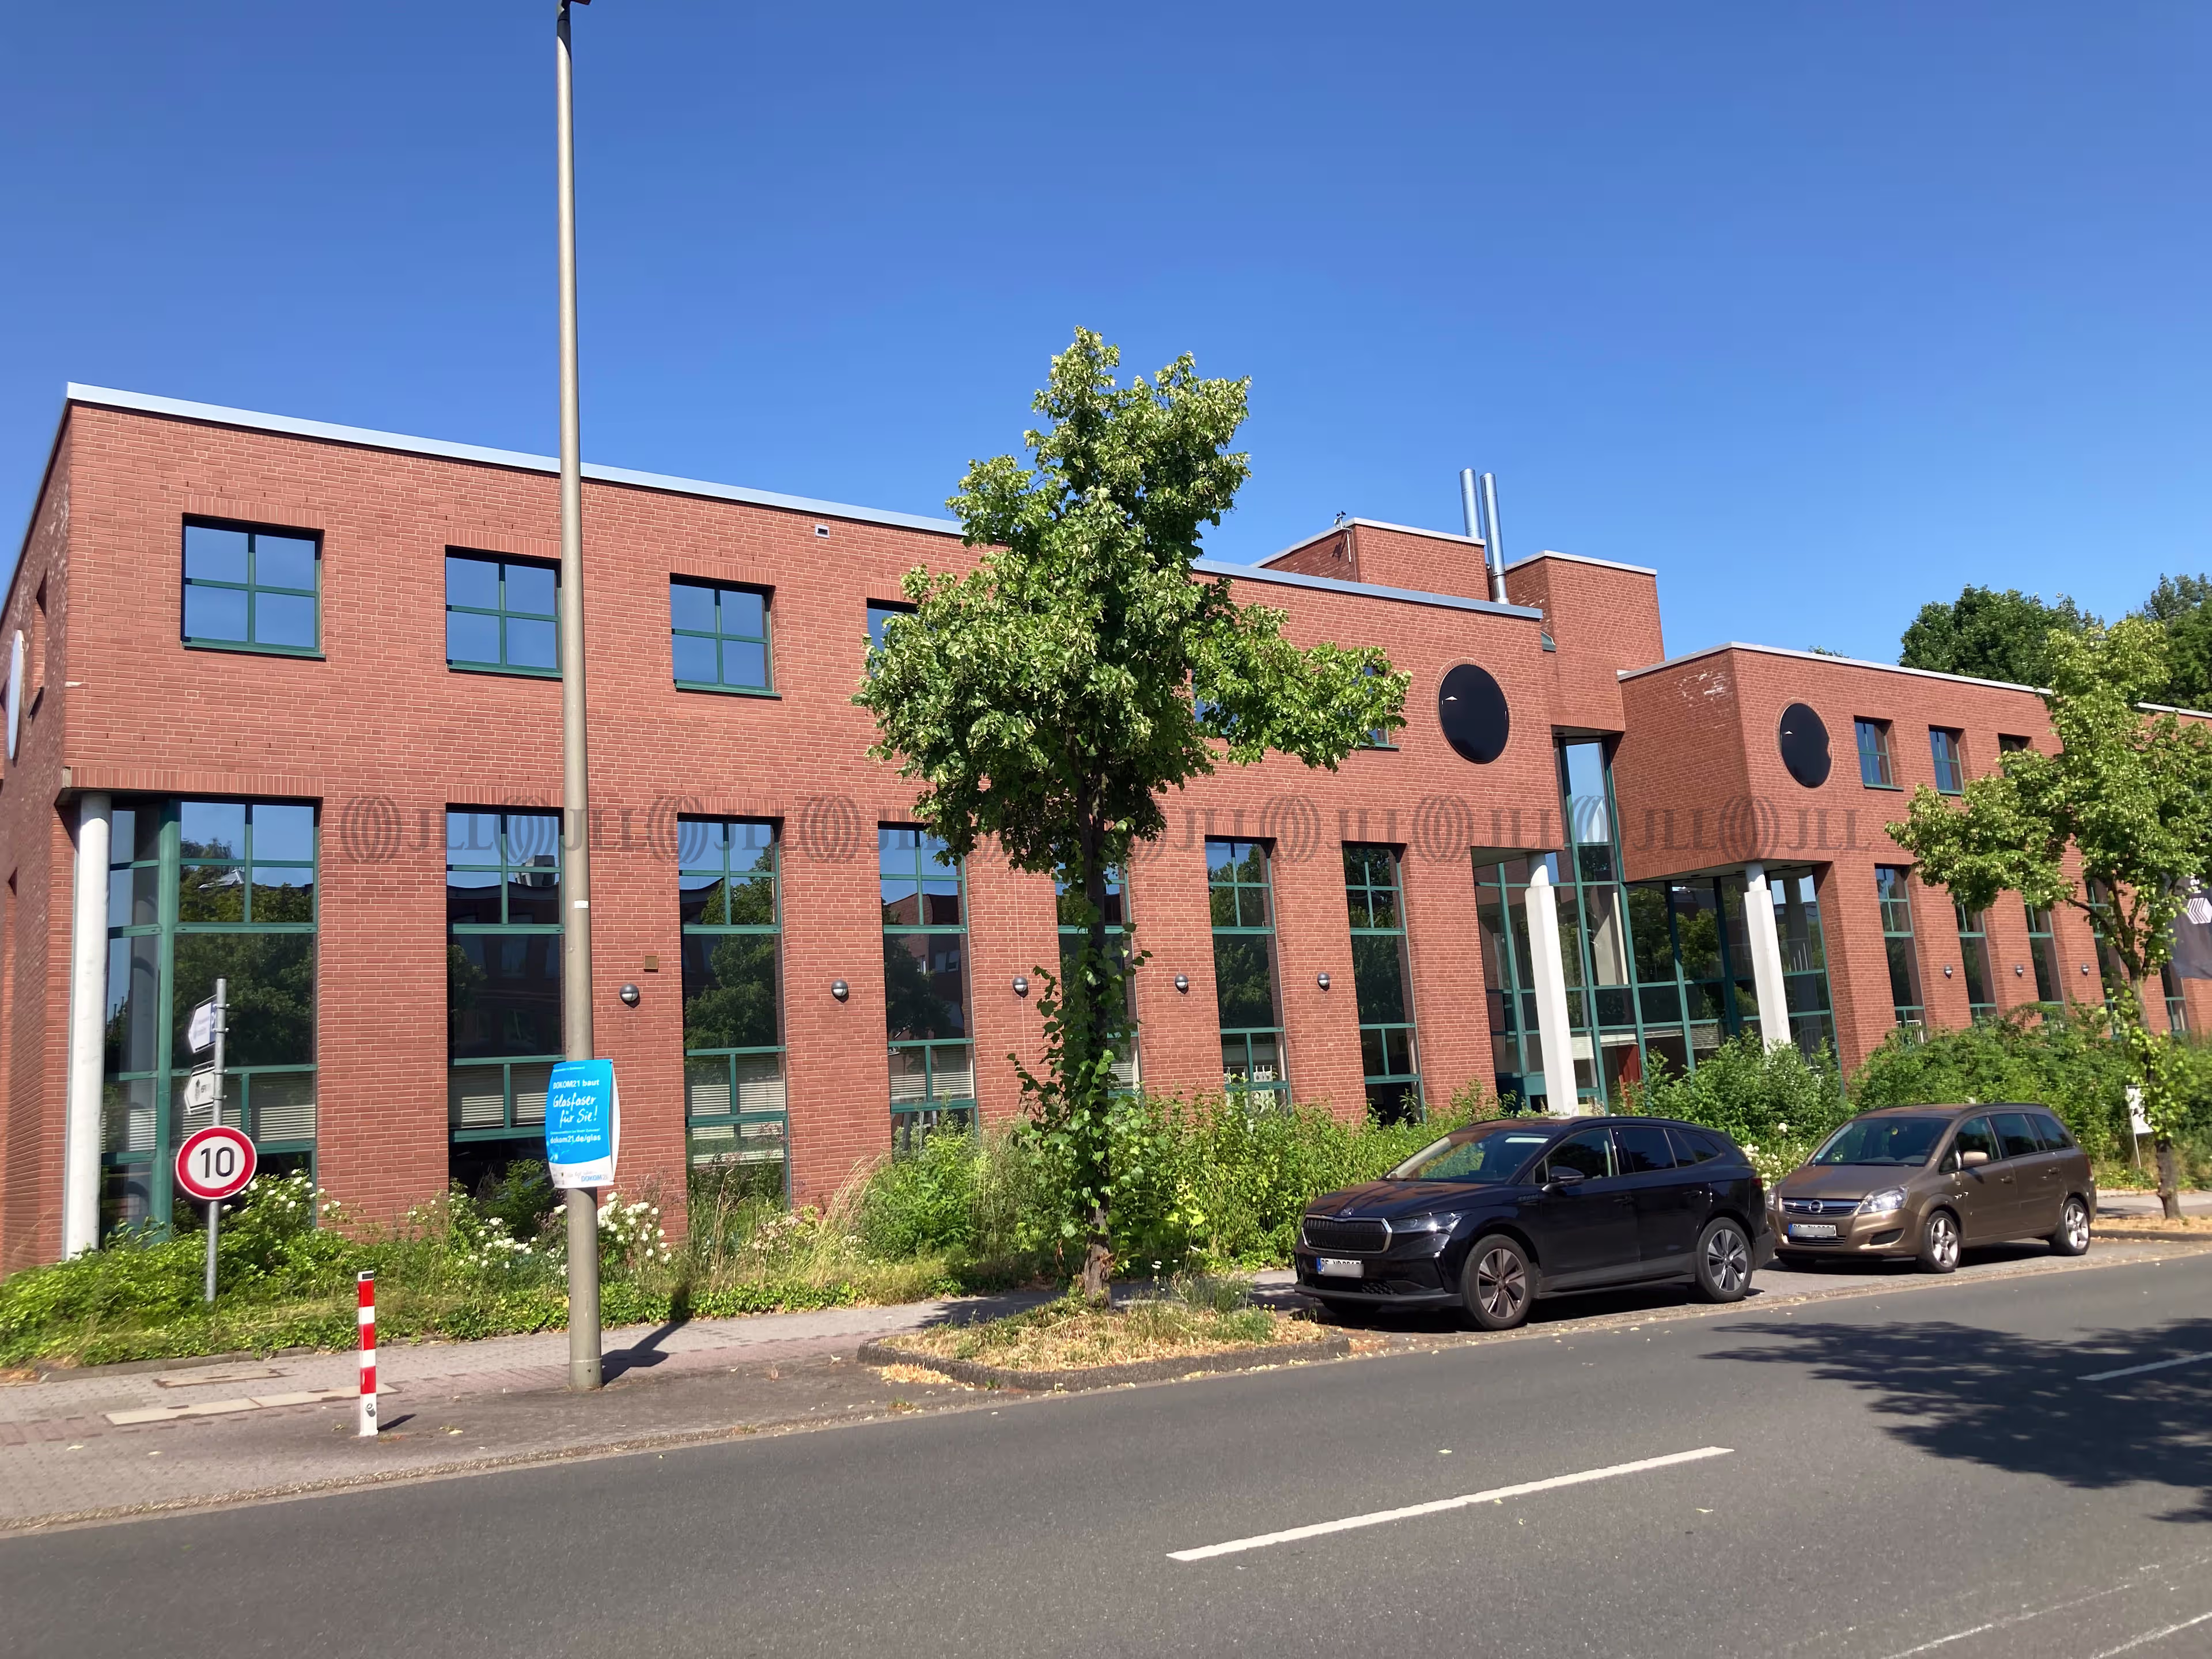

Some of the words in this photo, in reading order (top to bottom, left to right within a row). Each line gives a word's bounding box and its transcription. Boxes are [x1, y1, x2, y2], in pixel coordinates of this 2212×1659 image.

[582, 1079, 600, 1087] baut
[553, 1092, 597, 1111] Glasfaser
[559, 1109, 575, 1128] für
[577, 1105, 598, 1123] Sie!
[200, 1146, 235, 1178] 10
